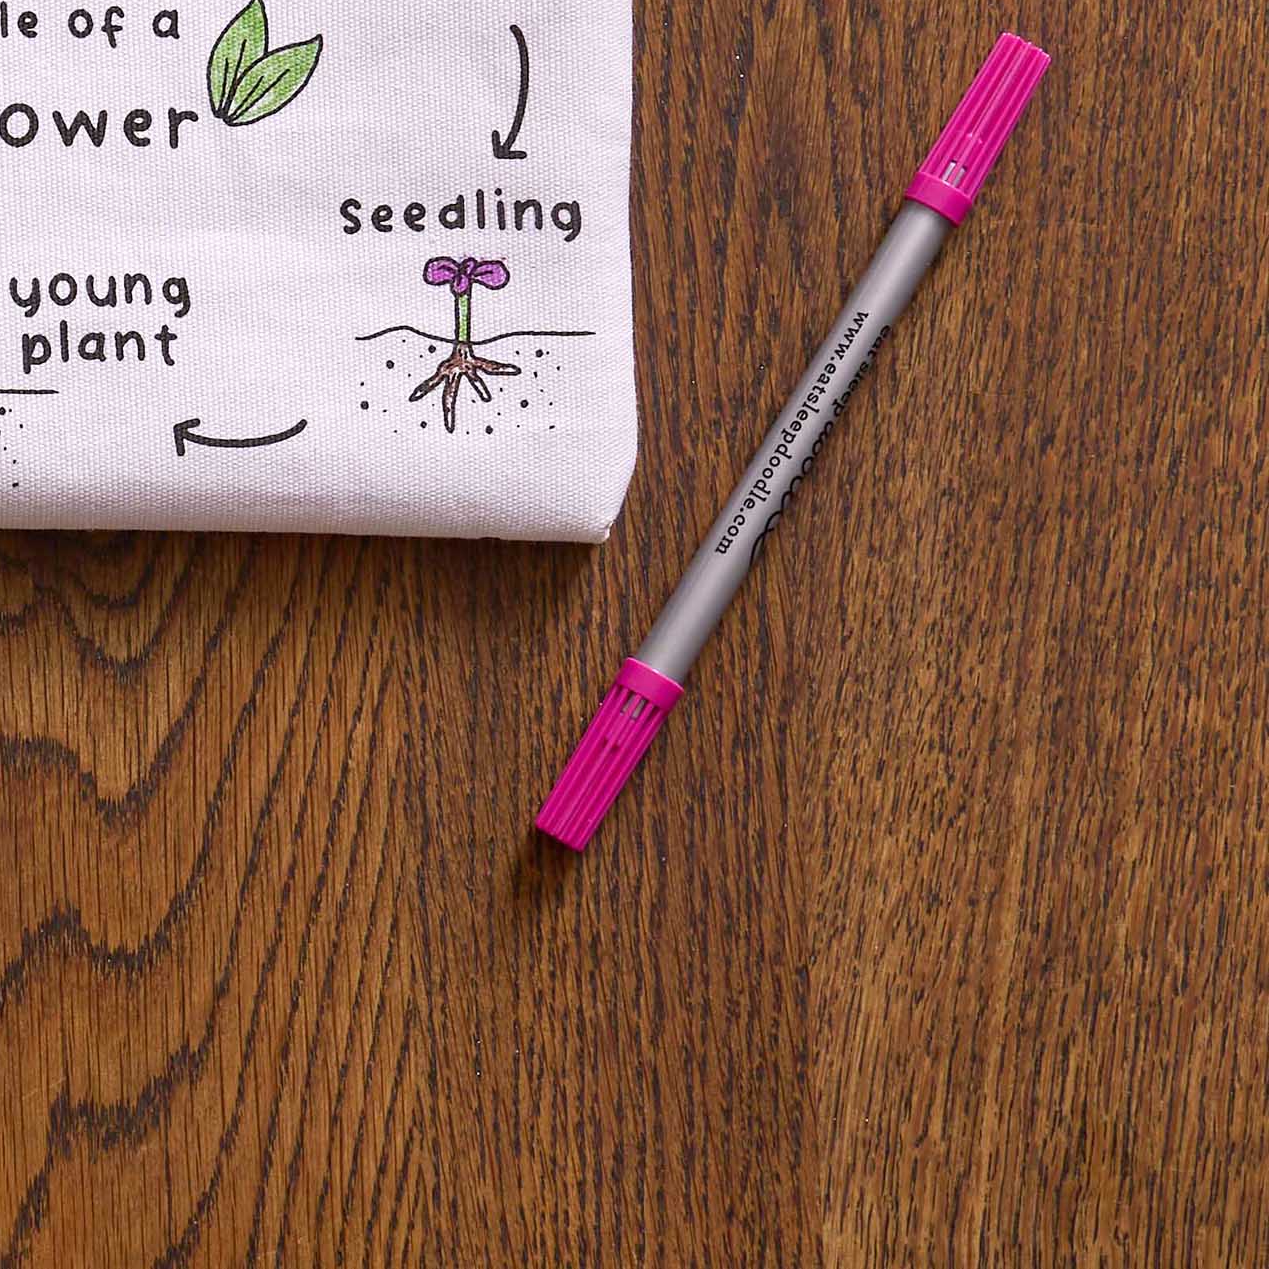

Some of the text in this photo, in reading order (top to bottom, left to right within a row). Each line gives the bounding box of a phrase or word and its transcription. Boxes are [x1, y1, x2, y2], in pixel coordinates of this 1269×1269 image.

[67, 5, 125, 49] of
[152, 9, 180, 40] a
[339, 187, 582, 243] seedling
[9, 272, 191, 323] young
[21, 319, 178, 375] plant
[715, 310, 869, 555] www.eatsleepdoodle.com
